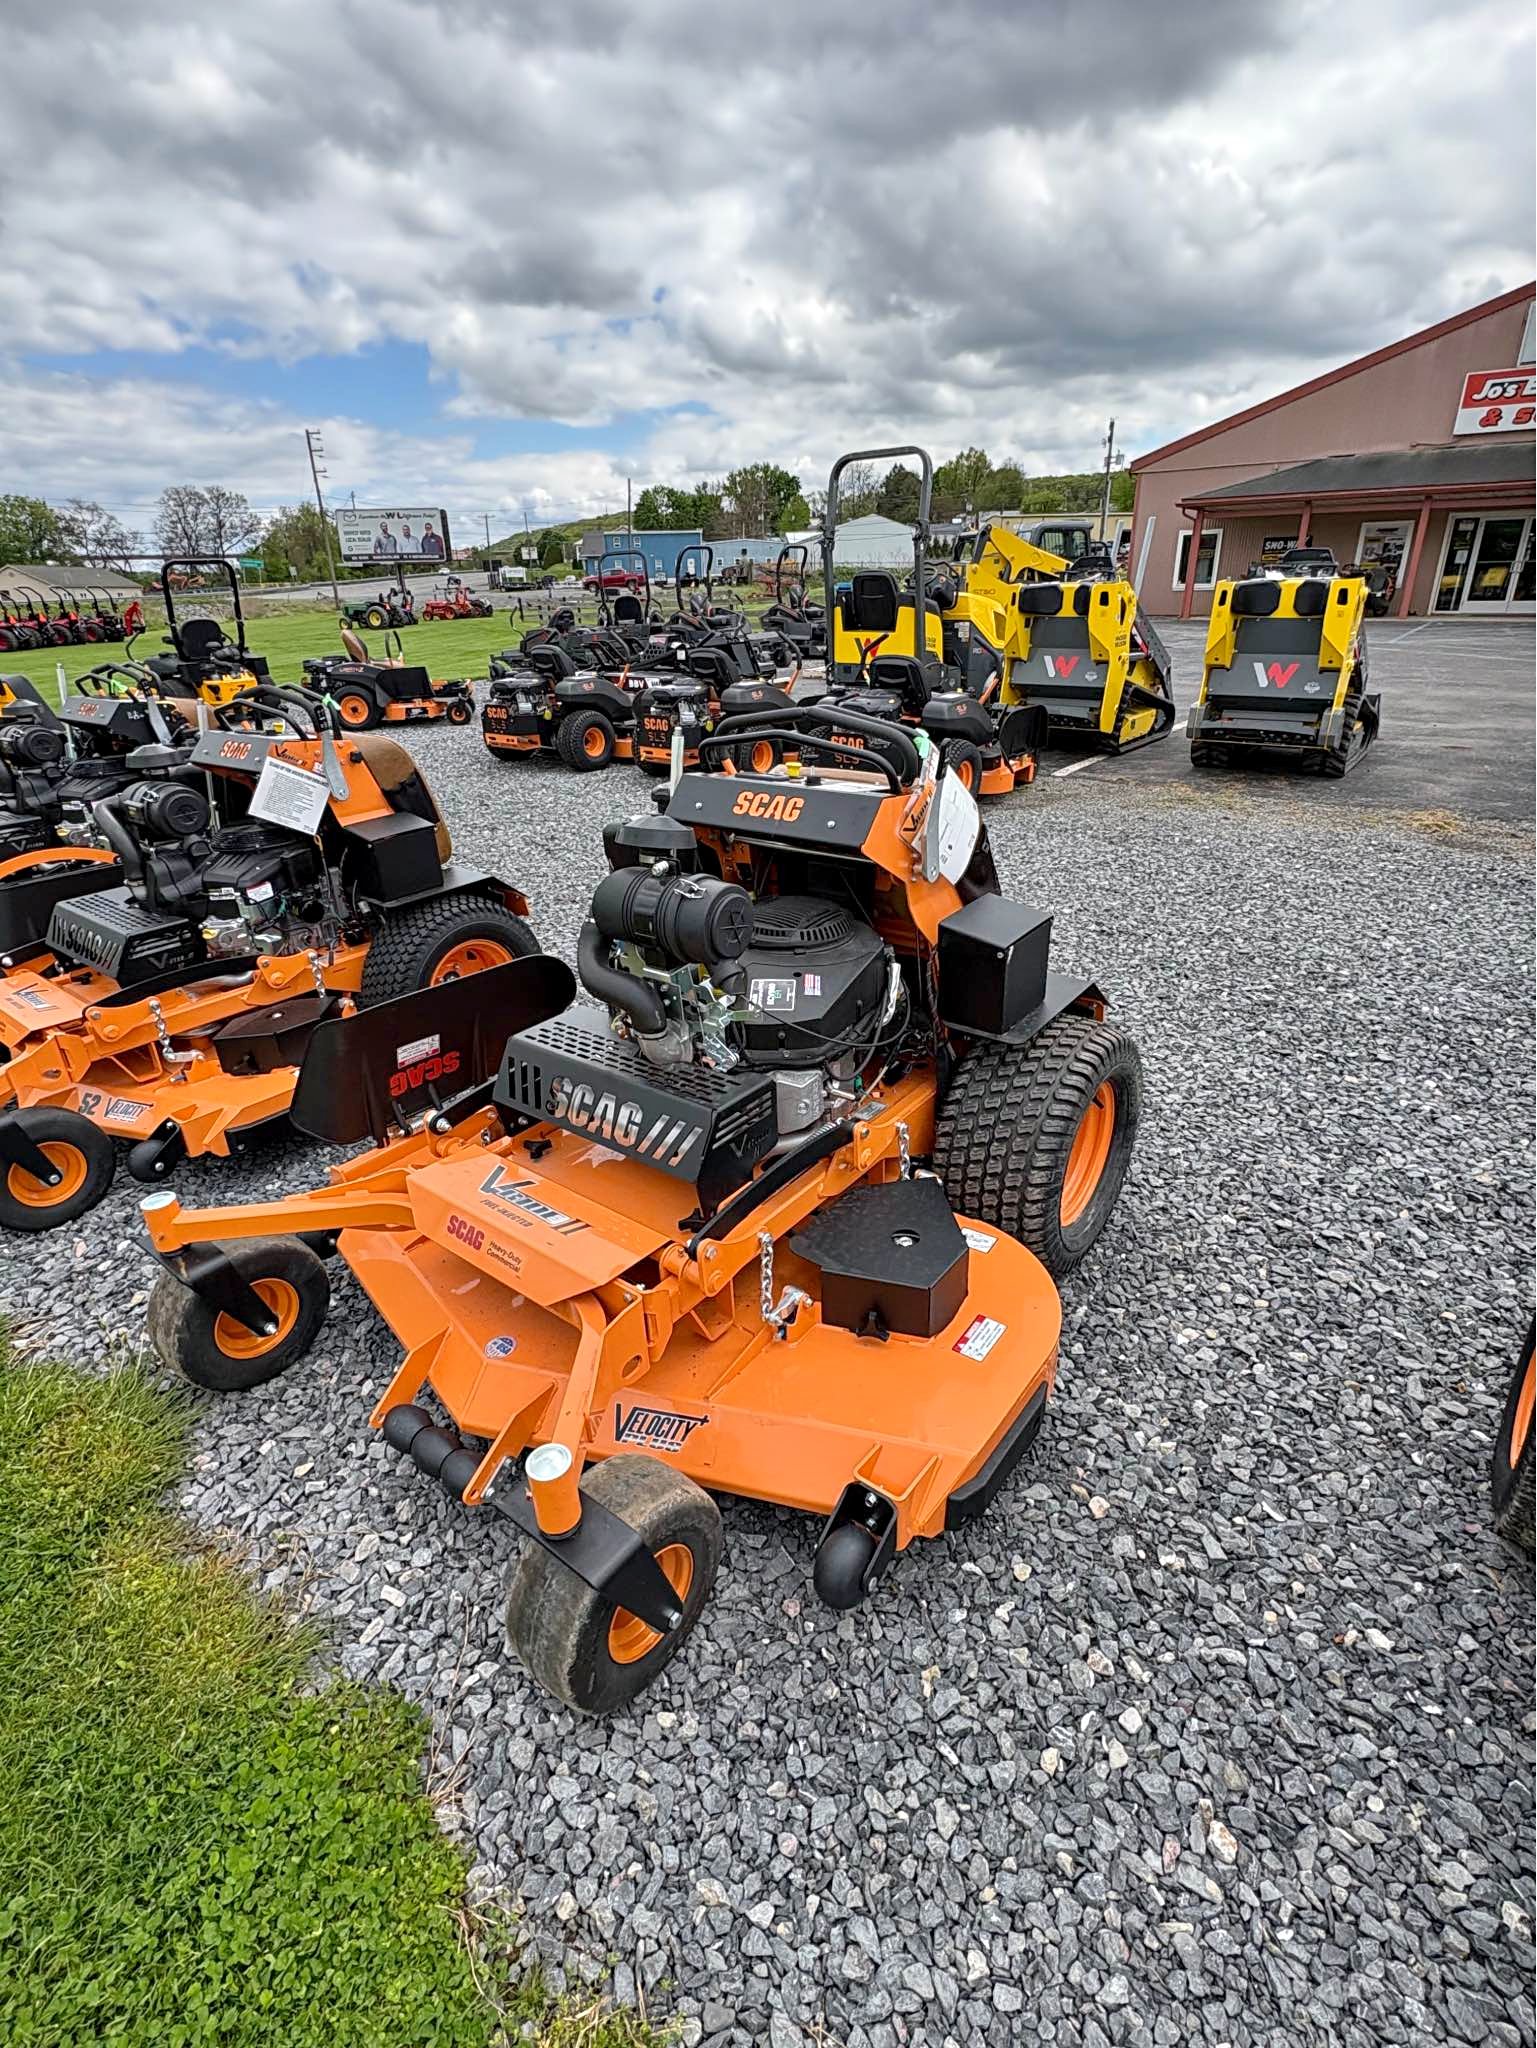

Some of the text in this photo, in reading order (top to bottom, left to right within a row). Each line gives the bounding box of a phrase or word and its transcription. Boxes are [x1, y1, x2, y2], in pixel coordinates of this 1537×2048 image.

[1471, 378, 1519, 401] Jo's
[1480, 407, 1503, 428] &
[486, 707, 508, 719] SCAG
[644, 717, 669, 732] SCAG
[648, 731, 666, 743] SLS
[220, 740, 252, 760] SCAG
[732, 790, 805, 822] SCAG
[389, 1050, 460, 1097] SCAG
[79, 1093, 102, 1117] 52
[546, 1076, 644, 1147] SCAG
[446, 1213, 523, 1266] SCAG Heavy-Duty
[486, 1247, 522, 1273] Commercial
